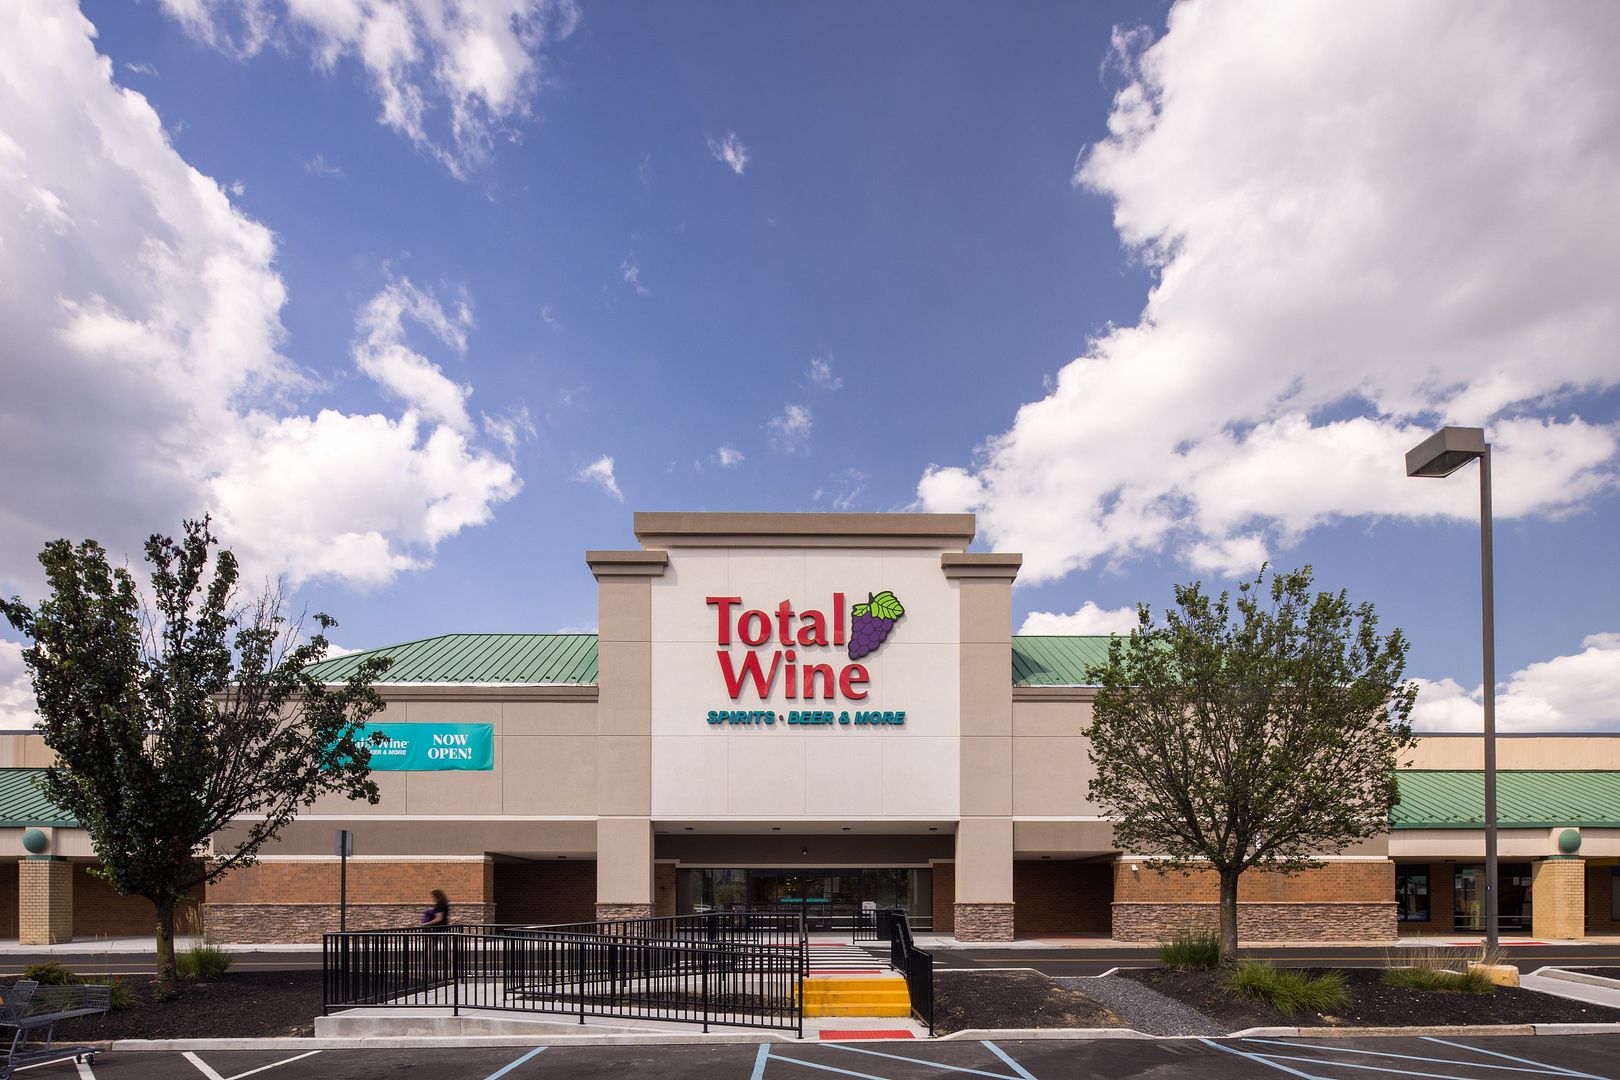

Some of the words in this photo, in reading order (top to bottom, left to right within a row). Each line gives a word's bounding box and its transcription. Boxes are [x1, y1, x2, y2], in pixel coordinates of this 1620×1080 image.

[706, 592, 844, 646] Total
[717, 650, 870, 700] Wine
[707, 711, 775, 725] SPIRITS
[788, 711, 834, 725] BEER
[838, 711, 850, 725] &
[854, 711, 905, 725] MORE
[433, 734, 469, 746] NOW
[427, 747, 472, 760] OPEN!
